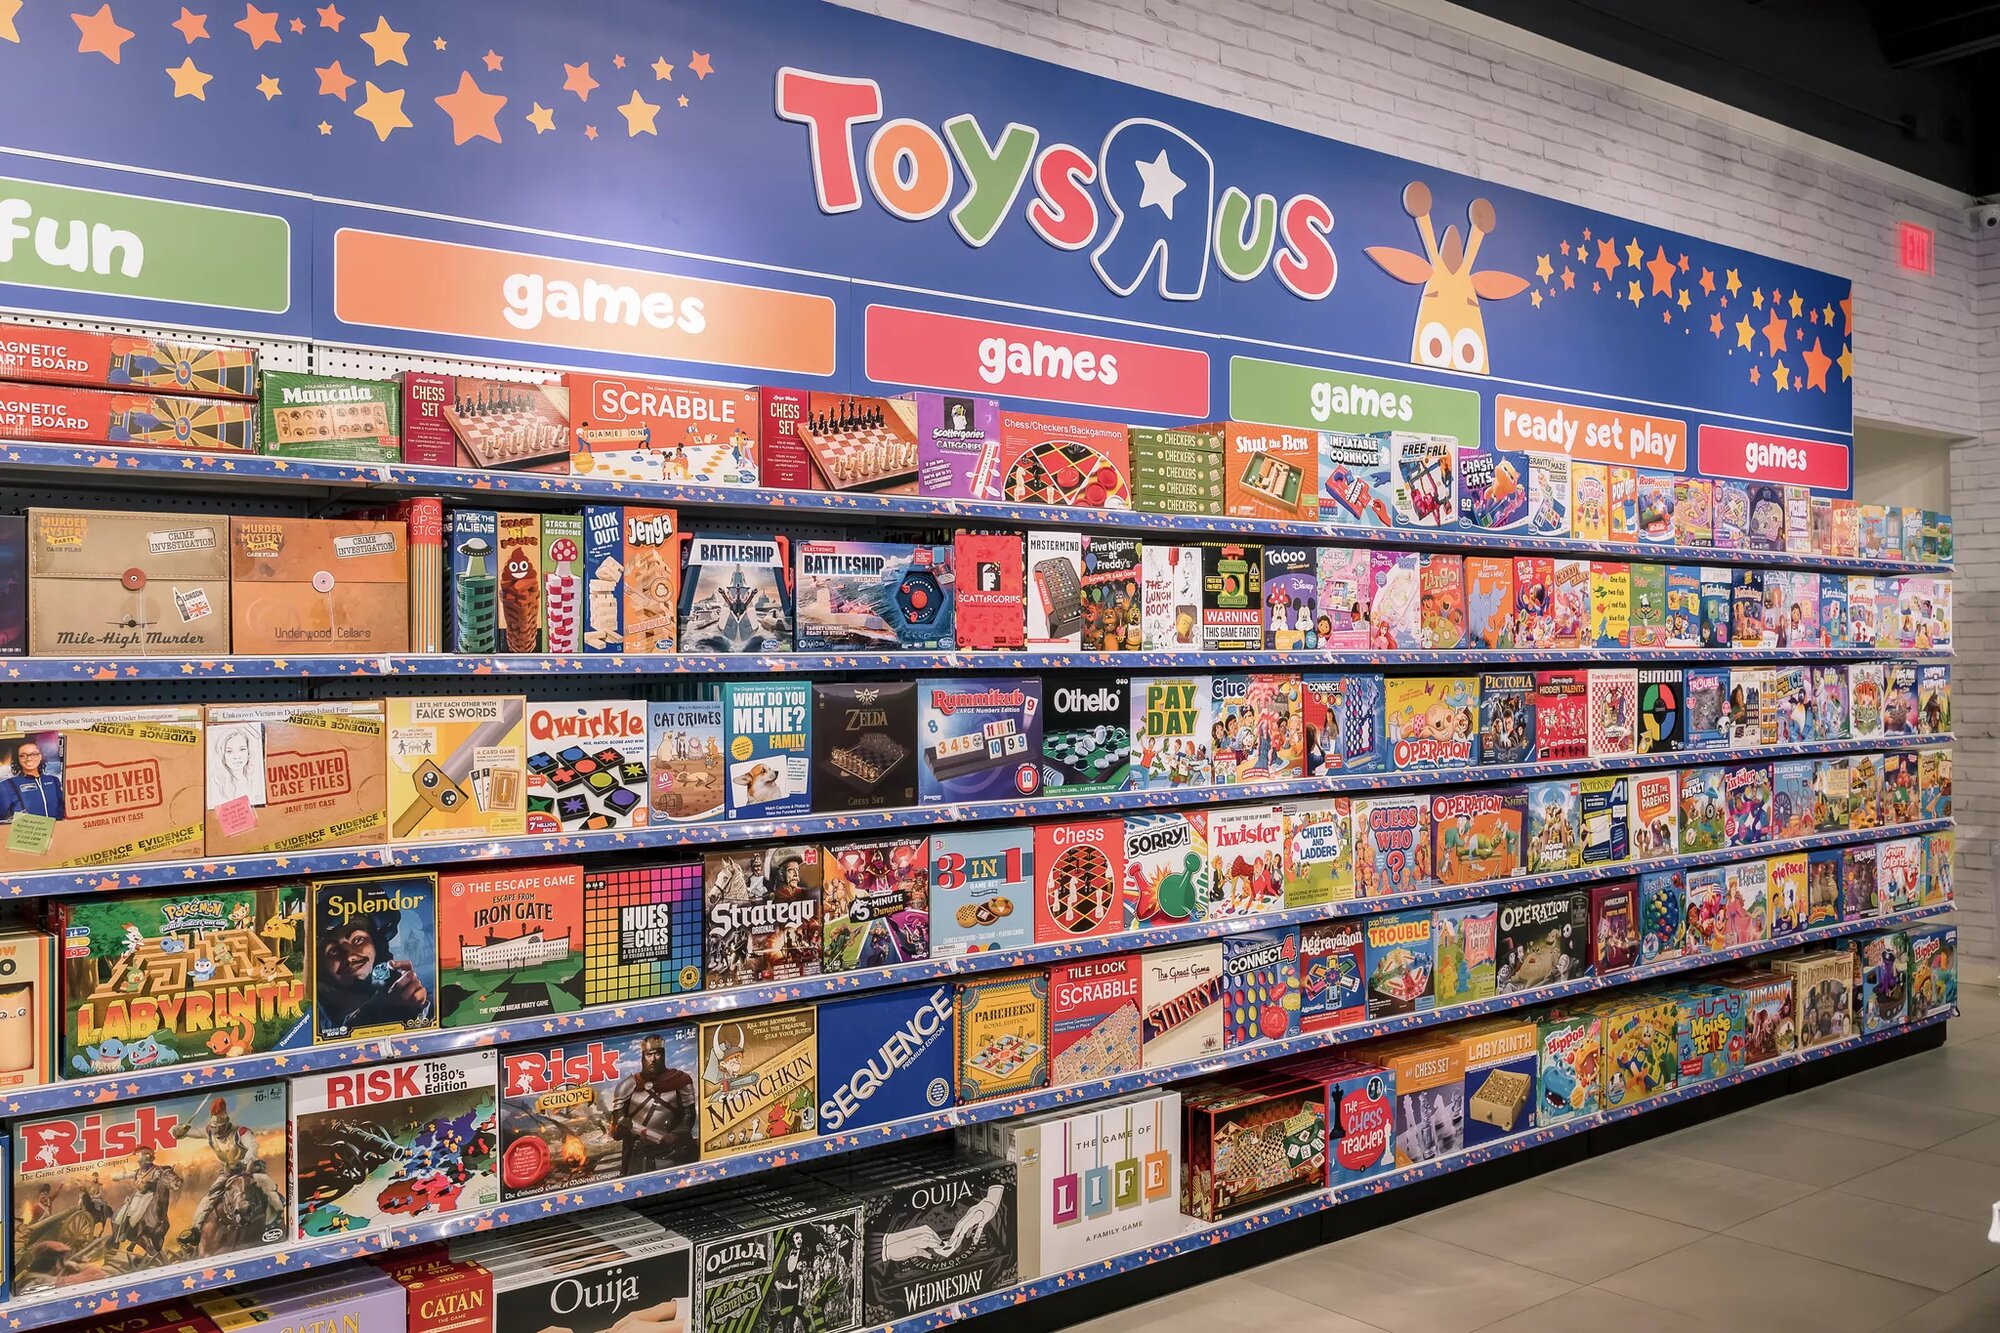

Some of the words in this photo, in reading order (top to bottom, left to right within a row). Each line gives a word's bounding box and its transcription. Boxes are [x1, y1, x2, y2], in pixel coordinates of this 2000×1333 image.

[0, 198, 145, 279] fun
[502, 272, 707, 335] games
[977, 336, 1119, 385] games
[280, 385, 373, 404] Mancala
[412, 385, 445, 402] CHESS
[1310, 382, 1413, 422] games
[421, 402, 440, 418] SET
[601, 388, 735, 424] SCRABBLE
[770, 402, 800, 420] CHESS
[778, 420, 795, 436] SET
[1503, 407, 1579, 453] ready
[1585, 425, 1624, 451] set
[1630, 420, 1678, 465] play
[1164, 433, 1196, 447] CHECKERS
[1329, 435, 1378, 451] INFLATABLE
[1164, 450, 1197, 464] CHECKERS
[1401, 443, 1426, 456] FREE
[1426, 444, 1449, 457] FALL
[1745, 443, 1808, 474] games
[1330, 451, 1379, 467] CORNHOLE
[1460, 458, 1494, 474] CRASH
[1551, 462, 1567, 471] MAZE
[1166, 466, 1197, 480] CHECKERS
[1465, 473, 1493, 489] CATS
[1166, 483, 1197, 496] CHECKERS
[1167, 499, 1198, 513] CHECKERS
[40, 516, 88, 528] MURDER
[412, 514, 428, 524] UP
[456, 513, 480, 523] STACK
[480, 514, 495, 523] THE
[545, 520, 567, 529] STACK
[567, 521, 582, 530] THE
[40, 527, 89, 538] MYSTERY
[168, 530, 195, 542] CRIME
[241, 524, 283, 535] MURDER
[456, 522, 495, 534] ALIENS
[545, 528, 582, 537] MUSHROOMS
[240, 532, 285, 544] MYSTERY
[352, 535, 377, 547] CRIME
[1030, 539, 1079, 552] MASTERMIND
[1090, 542, 1107, 552] Five
[1107, 540, 1134, 551] Nights
[700, 544, 774, 563] BATTLESHIP
[1108, 552, 1117, 560] at
[1265, 549, 1306, 566] Taboo
[803, 554, 885, 575] BATTLESHIP
[1096, 559, 1130, 570] Freddy's
[1421, 567, 1460, 592] Zingo!
[958, 594, 1021, 604] SCATTERGORIES
[1145, 591, 1172, 604] LUNCH
[1145, 605, 1170, 617] ROOM
[1206, 611, 1259, 624] WARNING
[57, 631, 140, 645] Mile-High
[146, 632, 206, 645] Murder
[274, 627, 332, 642] Underwood
[336, 627, 371, 639] Cellars
[1205, 627, 1220, 639] THIS
[1220, 627, 1237, 639] GAME
[1238, 627, 1260, 639] FARTS!
[1484, 675, 1533, 689] PICTOPIA
[1539, 685, 1561, 695] HIDDEN
[1688, 675, 1720, 691] TROUBLE
[733, 692, 766, 707] WHAT
[767, 692, 784, 706] DO
[785, 691, 806, 706] YOU
[1026, 699, 1035, 711] 9
[1053, 687, 1119, 714] Othello
[1148, 685, 1197, 710] PAY
[416, 708, 446, 719] FAKE
[448, 707, 497, 719] SWORDS
[1001, 706, 1021, 714] Edition
[529, 707, 645, 741] Qwirkle
[732, 706, 806, 735] MEME?
[1147, 710, 1199, 738] DAY
[938, 741, 947, 755] 3
[951, 739, 959, 752] 4
[963, 736, 970, 750] 5
[1394, 738, 1472, 769] OPERATION
[267, 757, 344, 783] UNSOLVED
[66, 766, 154, 797] UNSOLVED
[1641, 783, 1659, 796] BEAT
[1659, 784, 1668, 792] THE
[1681, 783, 1705, 800] FRENZY
[1432, 795, 1503, 822] OPERATION
[1641, 793, 1670, 811] PARENTS
[1369, 807, 1418, 830] GUESS
[1053, 827, 1104, 846] Chess
[1127, 823, 1190, 858] SORRY!
[1213, 822, 1281, 848] Twister
[1301, 825, 1333, 840] CHUTES
[1375, 829, 1413, 851] WHO
[1312, 837, 1325, 847] AND
[1300, 845, 1337, 861] LADDERS
[1854, 848, 1877, 863] TROUBLE
[468, 883, 491, 893] THE
[494, 878, 542, 891] ESCAPE
[544, 875, 575, 887] GAME
[492, 894, 516, 903] ESCAPE
[517, 893, 535, 901] FROM
[327, 888, 424, 926] Splendor
[474, 906, 511, 929] IRON
[514, 902, 554, 922] GATE
[1500, 899, 1570, 932] OPERATION
[622, 903, 669, 931] HUES
[708, 899, 816, 938] Stratego
[1369, 919, 1430, 947] TROUBLE
[1300, 929, 1363, 956] Aggravation
[1068, 966, 1092, 979] TILE
[1094, 960, 1127, 975] LOCK
[1060, 978, 1138, 1007] SCRABBLE
[76, 980, 305, 1047] LABYRINTH
[1468, 1031, 1533, 1063] LABYRINTH
[1547, 1024, 1585, 1056] Hippos
[424, 1061, 447, 1072] The
[820, 987, 954, 1130] SEQUENCE
[504, 1042, 620, 1100] Risk
[327, 1064, 421, 1110] RISK
[425, 1079, 468, 1095] Edition
[705, 1051, 814, 1133] MUNCHKIN
[1344, 1100, 1359, 1115] THE
[20, 1105, 179, 1174] Risk
[1076, 1138, 1098, 1150] THE
[1102, 1129, 1133, 1144] GAME
[1137, 1124, 1152, 1136] OF
[20, 1173, 34, 1182] The
[34, 1169, 56, 1179] Game
[56, 1166, 66, 1175] of
[66, 1162, 96, 1175] Strategic
[97, 1157, 130, 1169] Conquest
[911, 1180, 973, 1210] OUIJA
[1085, 1234, 1091, 1243] A
[1093, 1226, 1120, 1241] FAMILY
[1121, 1219, 1144, 1233] GAME
[551, 1268, 640, 1314] Ouija
[420, 1288, 484, 1320] CATAN
